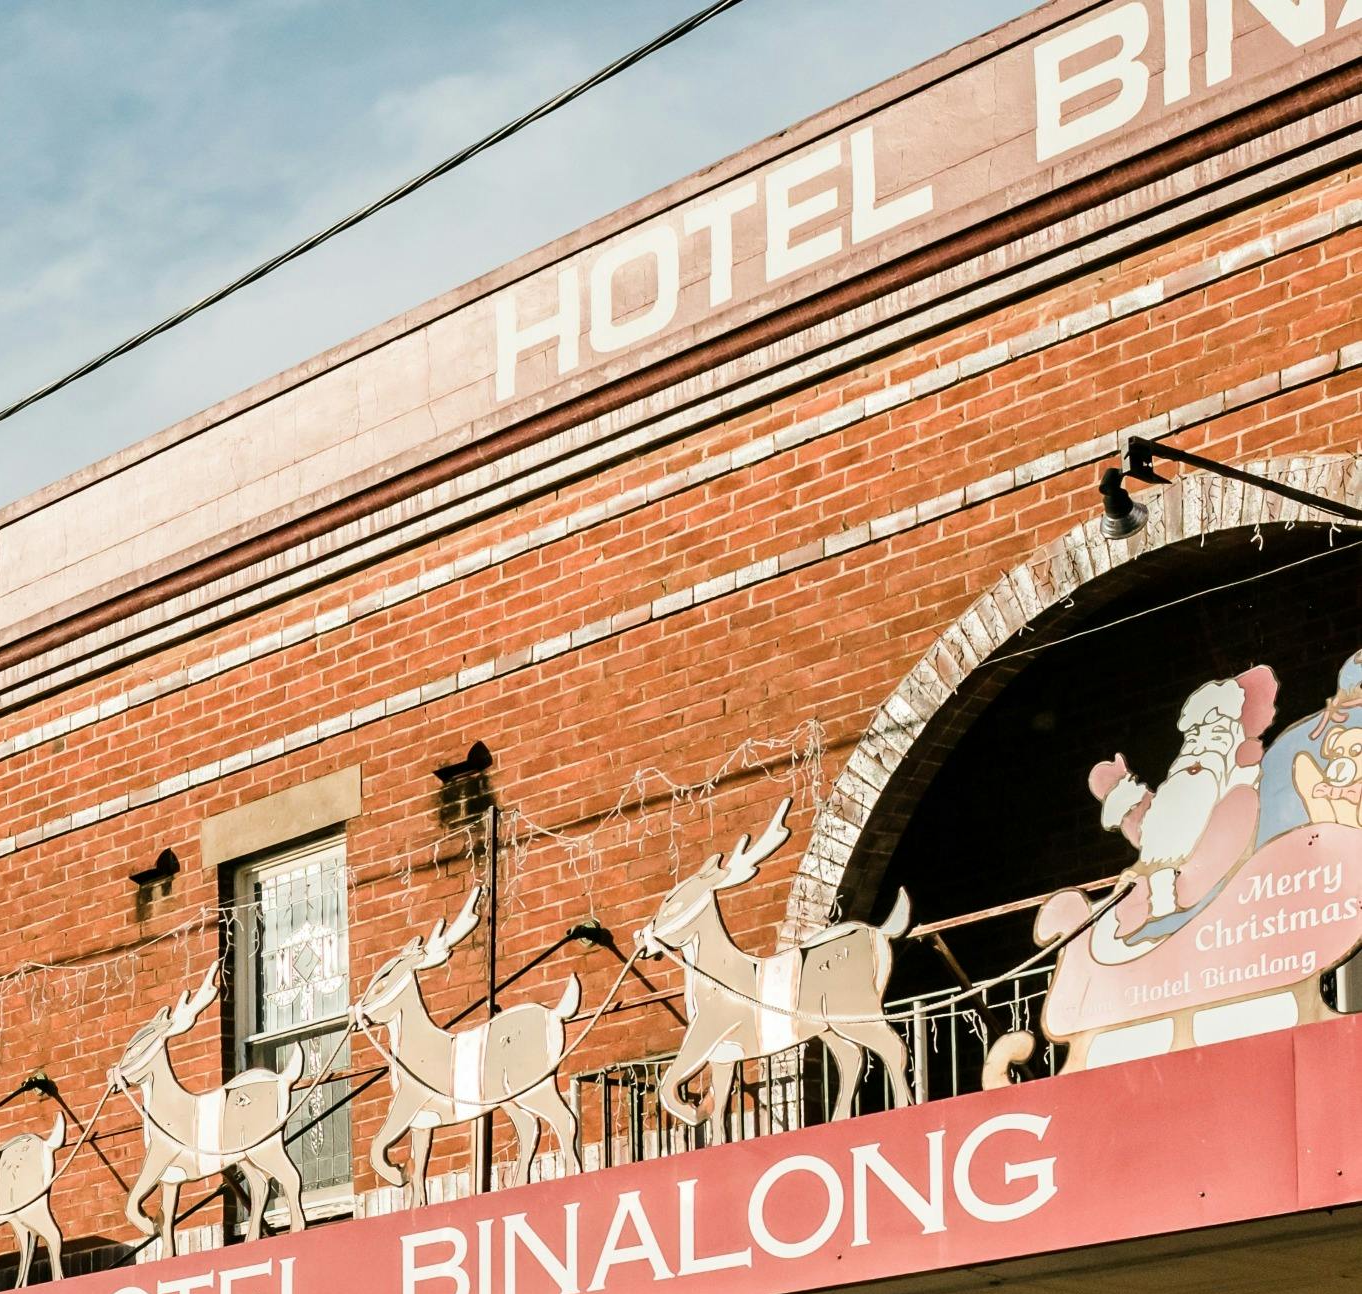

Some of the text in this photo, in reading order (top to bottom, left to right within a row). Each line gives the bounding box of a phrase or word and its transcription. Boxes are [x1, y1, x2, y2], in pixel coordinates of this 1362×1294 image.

[493, 0, 1362, 402] HOTEL BIN
[1238, 861, 1343, 905] Merry
[1195, 898, 1359, 952] Christmas
[1125, 950, 1317, 1006] Hotel Binalong
